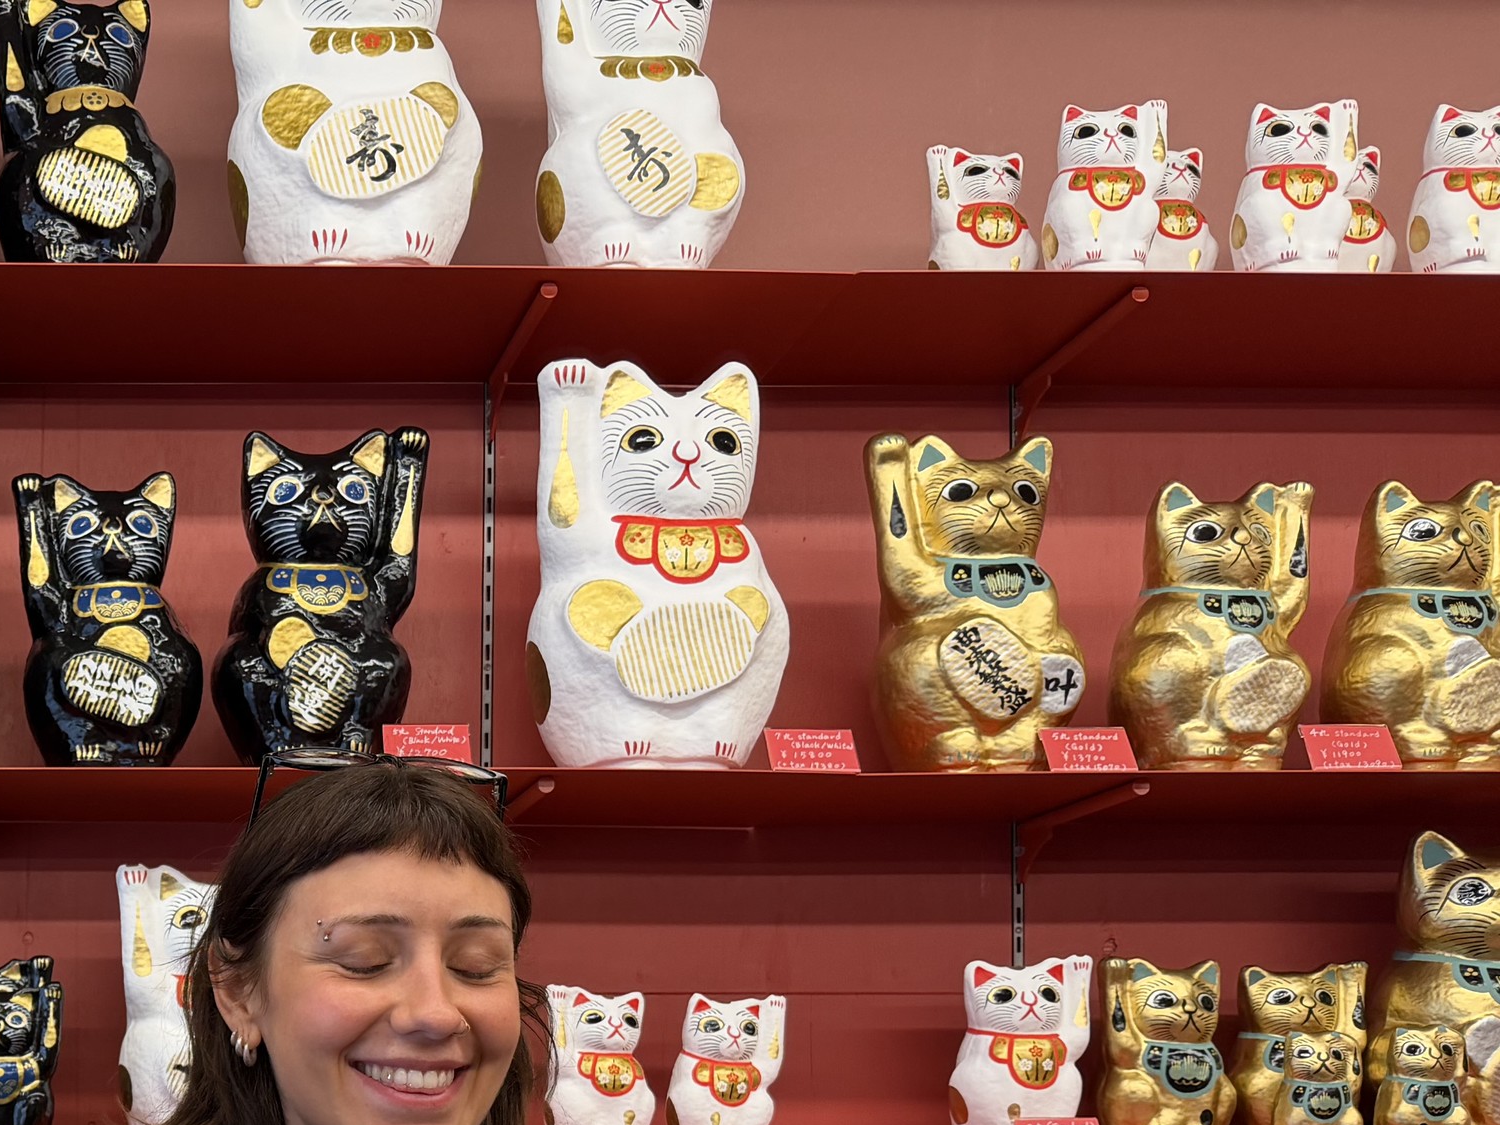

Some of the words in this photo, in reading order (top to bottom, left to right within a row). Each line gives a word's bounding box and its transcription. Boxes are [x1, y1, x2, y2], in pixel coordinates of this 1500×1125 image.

[345, 108, 405, 182] 寿
[619, 127, 673, 192] 寿
[78, 660, 160, 718] 招福
[287, 652, 346, 725] 開運
[1044, 668, 1078, 705] 叶
[415, 725, 455, 736] Standard
[1065, 742, 1103, 752] (Gold)
[1073, 732, 1118, 741] standard
[1331, 740, 1368, 749] (Gold)
